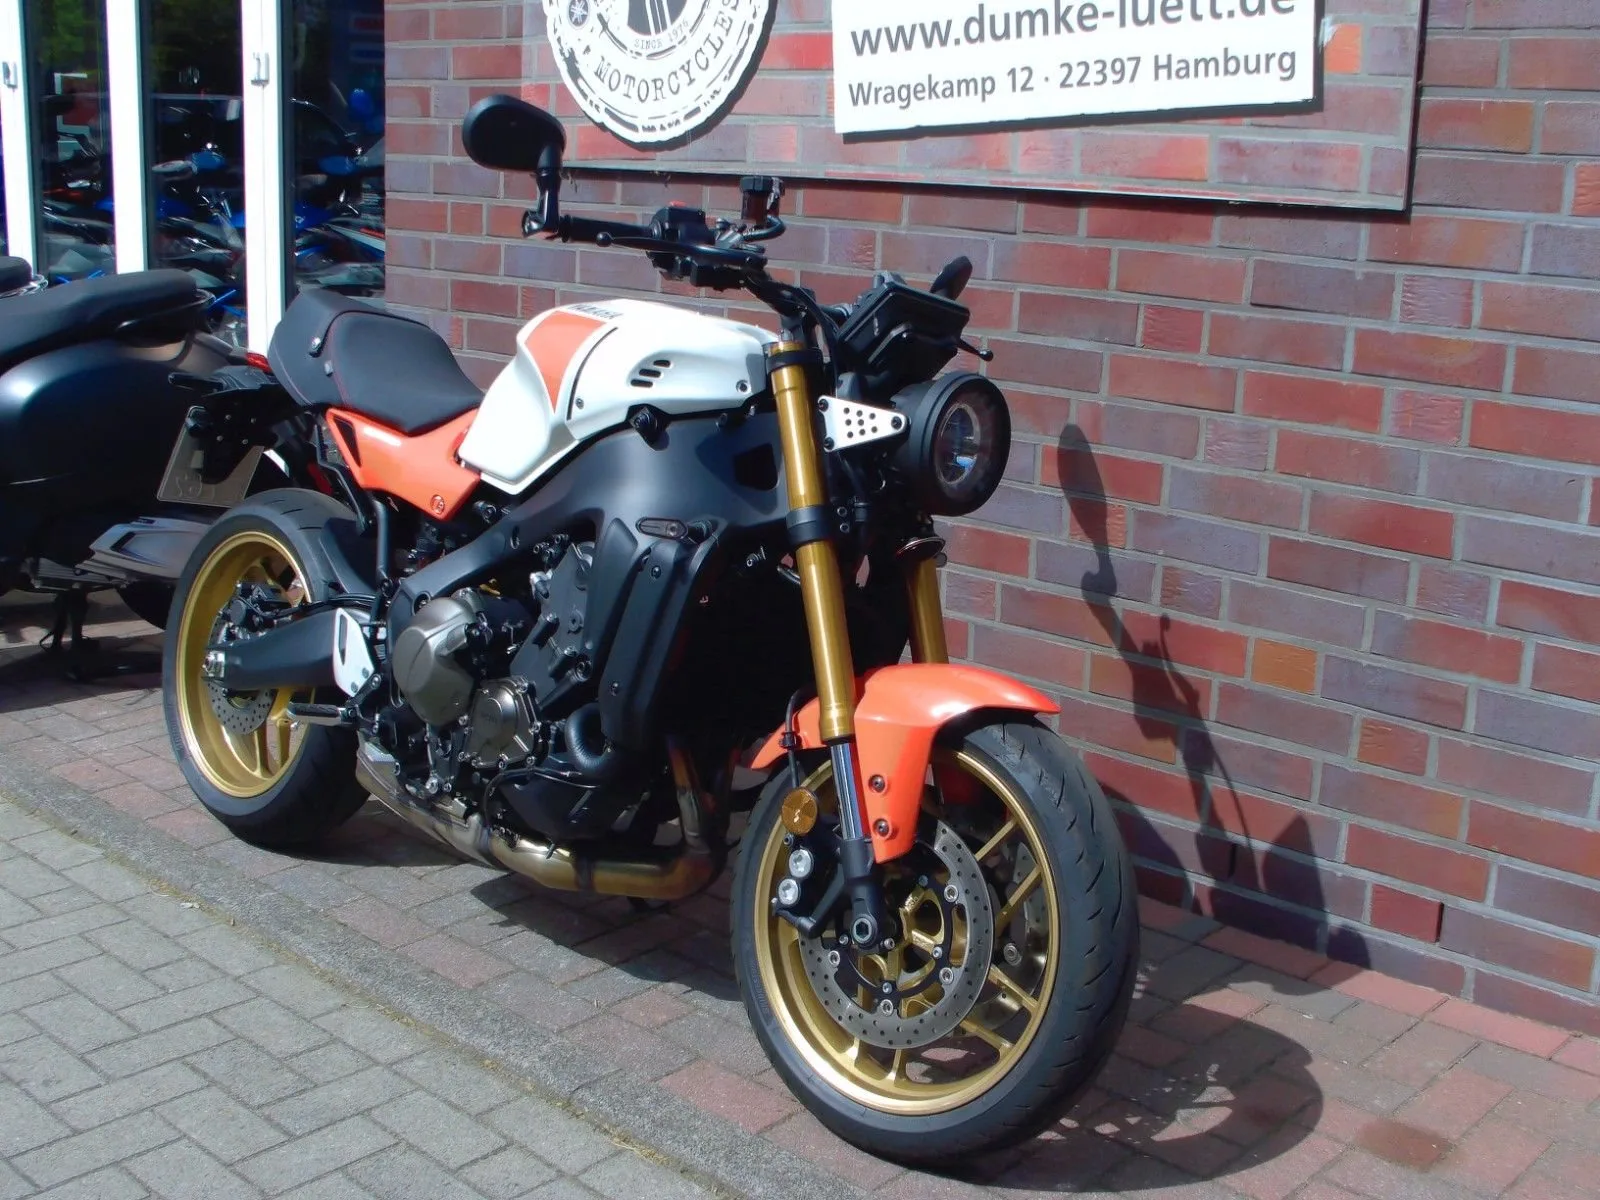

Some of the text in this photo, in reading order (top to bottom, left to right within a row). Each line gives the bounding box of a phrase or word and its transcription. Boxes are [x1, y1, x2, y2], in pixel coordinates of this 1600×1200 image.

[634, 39, 662, 50] SINCE
[849, 74, 996, 109] Wragekamp
[1007, 66, 1034, 92] 12
[1059, 57, 1142, 88] 22397
[1154, 48, 1296, 82] Hamburg
